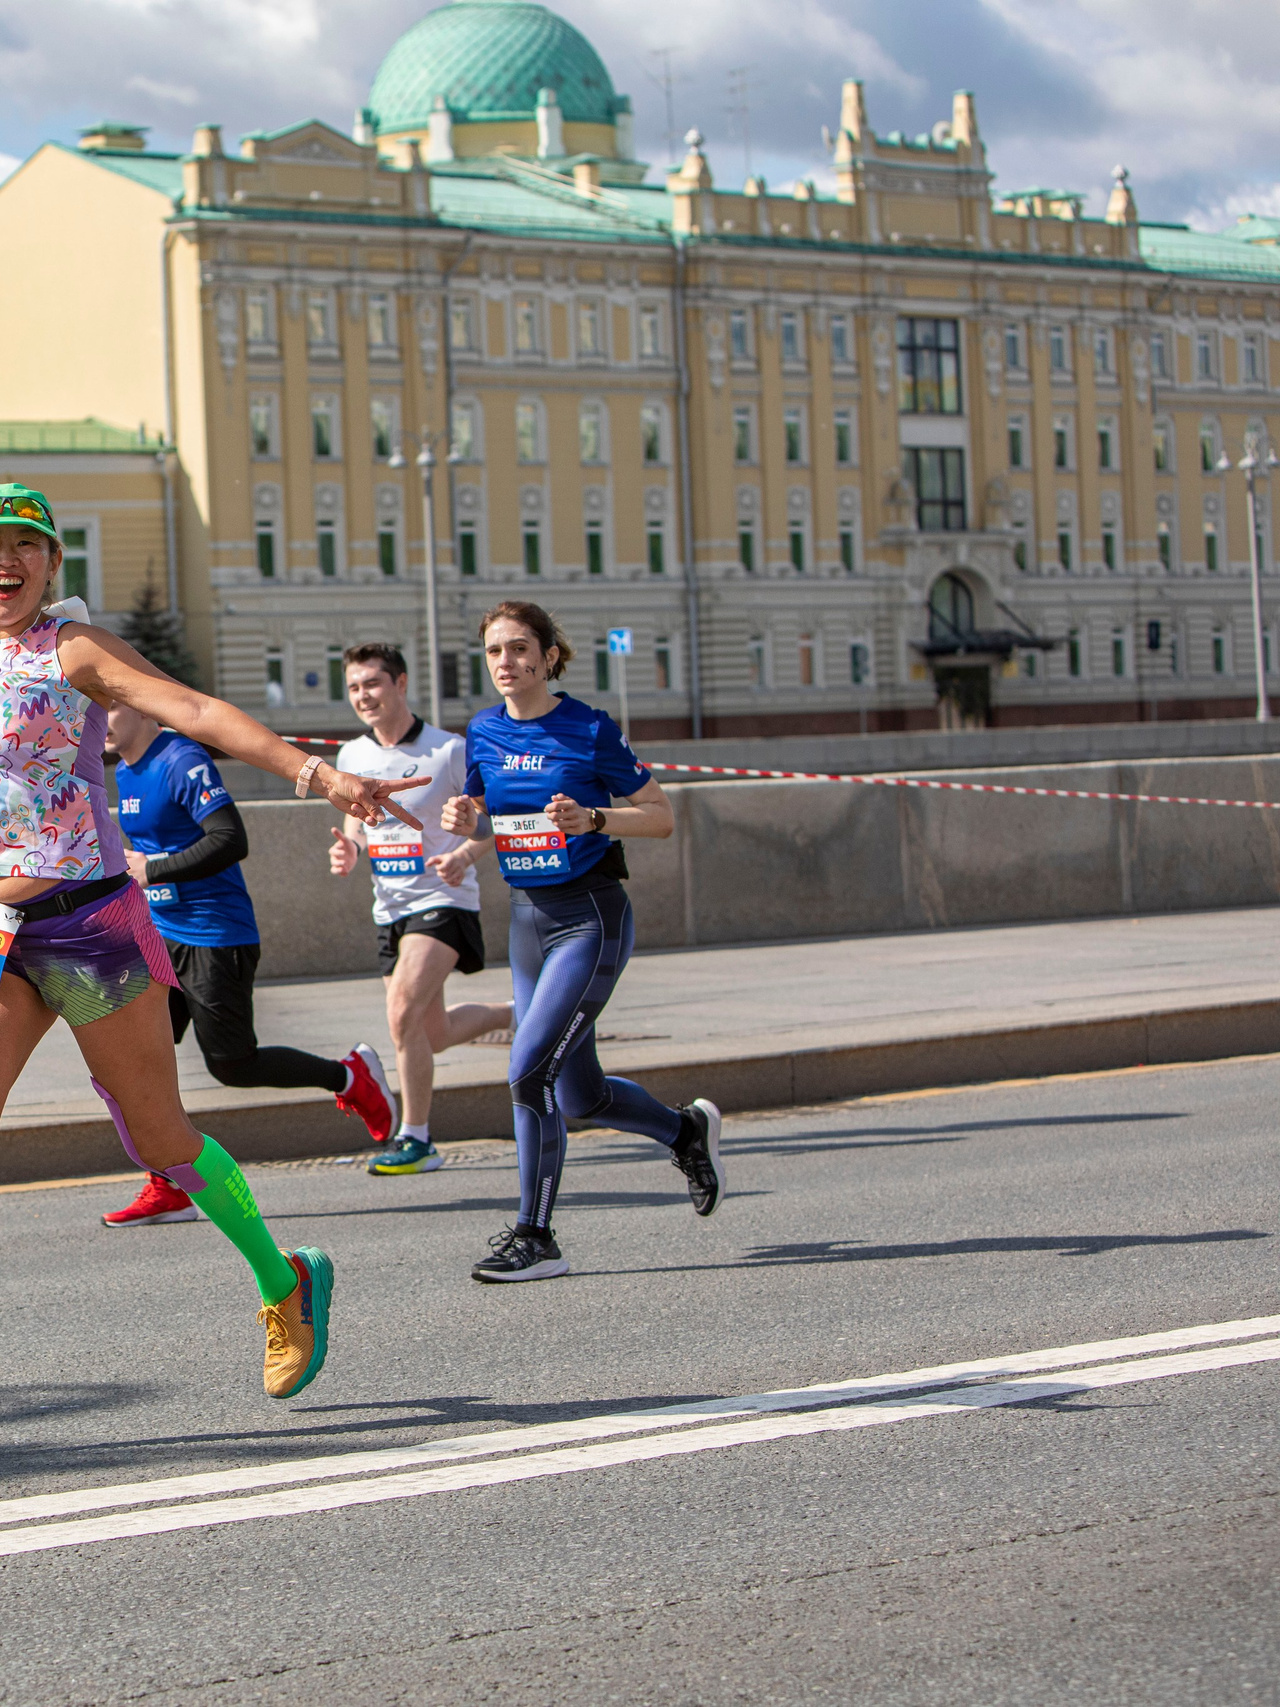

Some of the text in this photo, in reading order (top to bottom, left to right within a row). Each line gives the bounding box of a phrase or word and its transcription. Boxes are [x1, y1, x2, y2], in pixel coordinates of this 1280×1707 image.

[187, 764, 212, 786] 7
[375, 860, 416, 872] 10791
[505, 854, 561, 870] 12844
[553, 1011, 585, 1059] BOUNCE
[301, 1279, 312, 1325] HOKA
